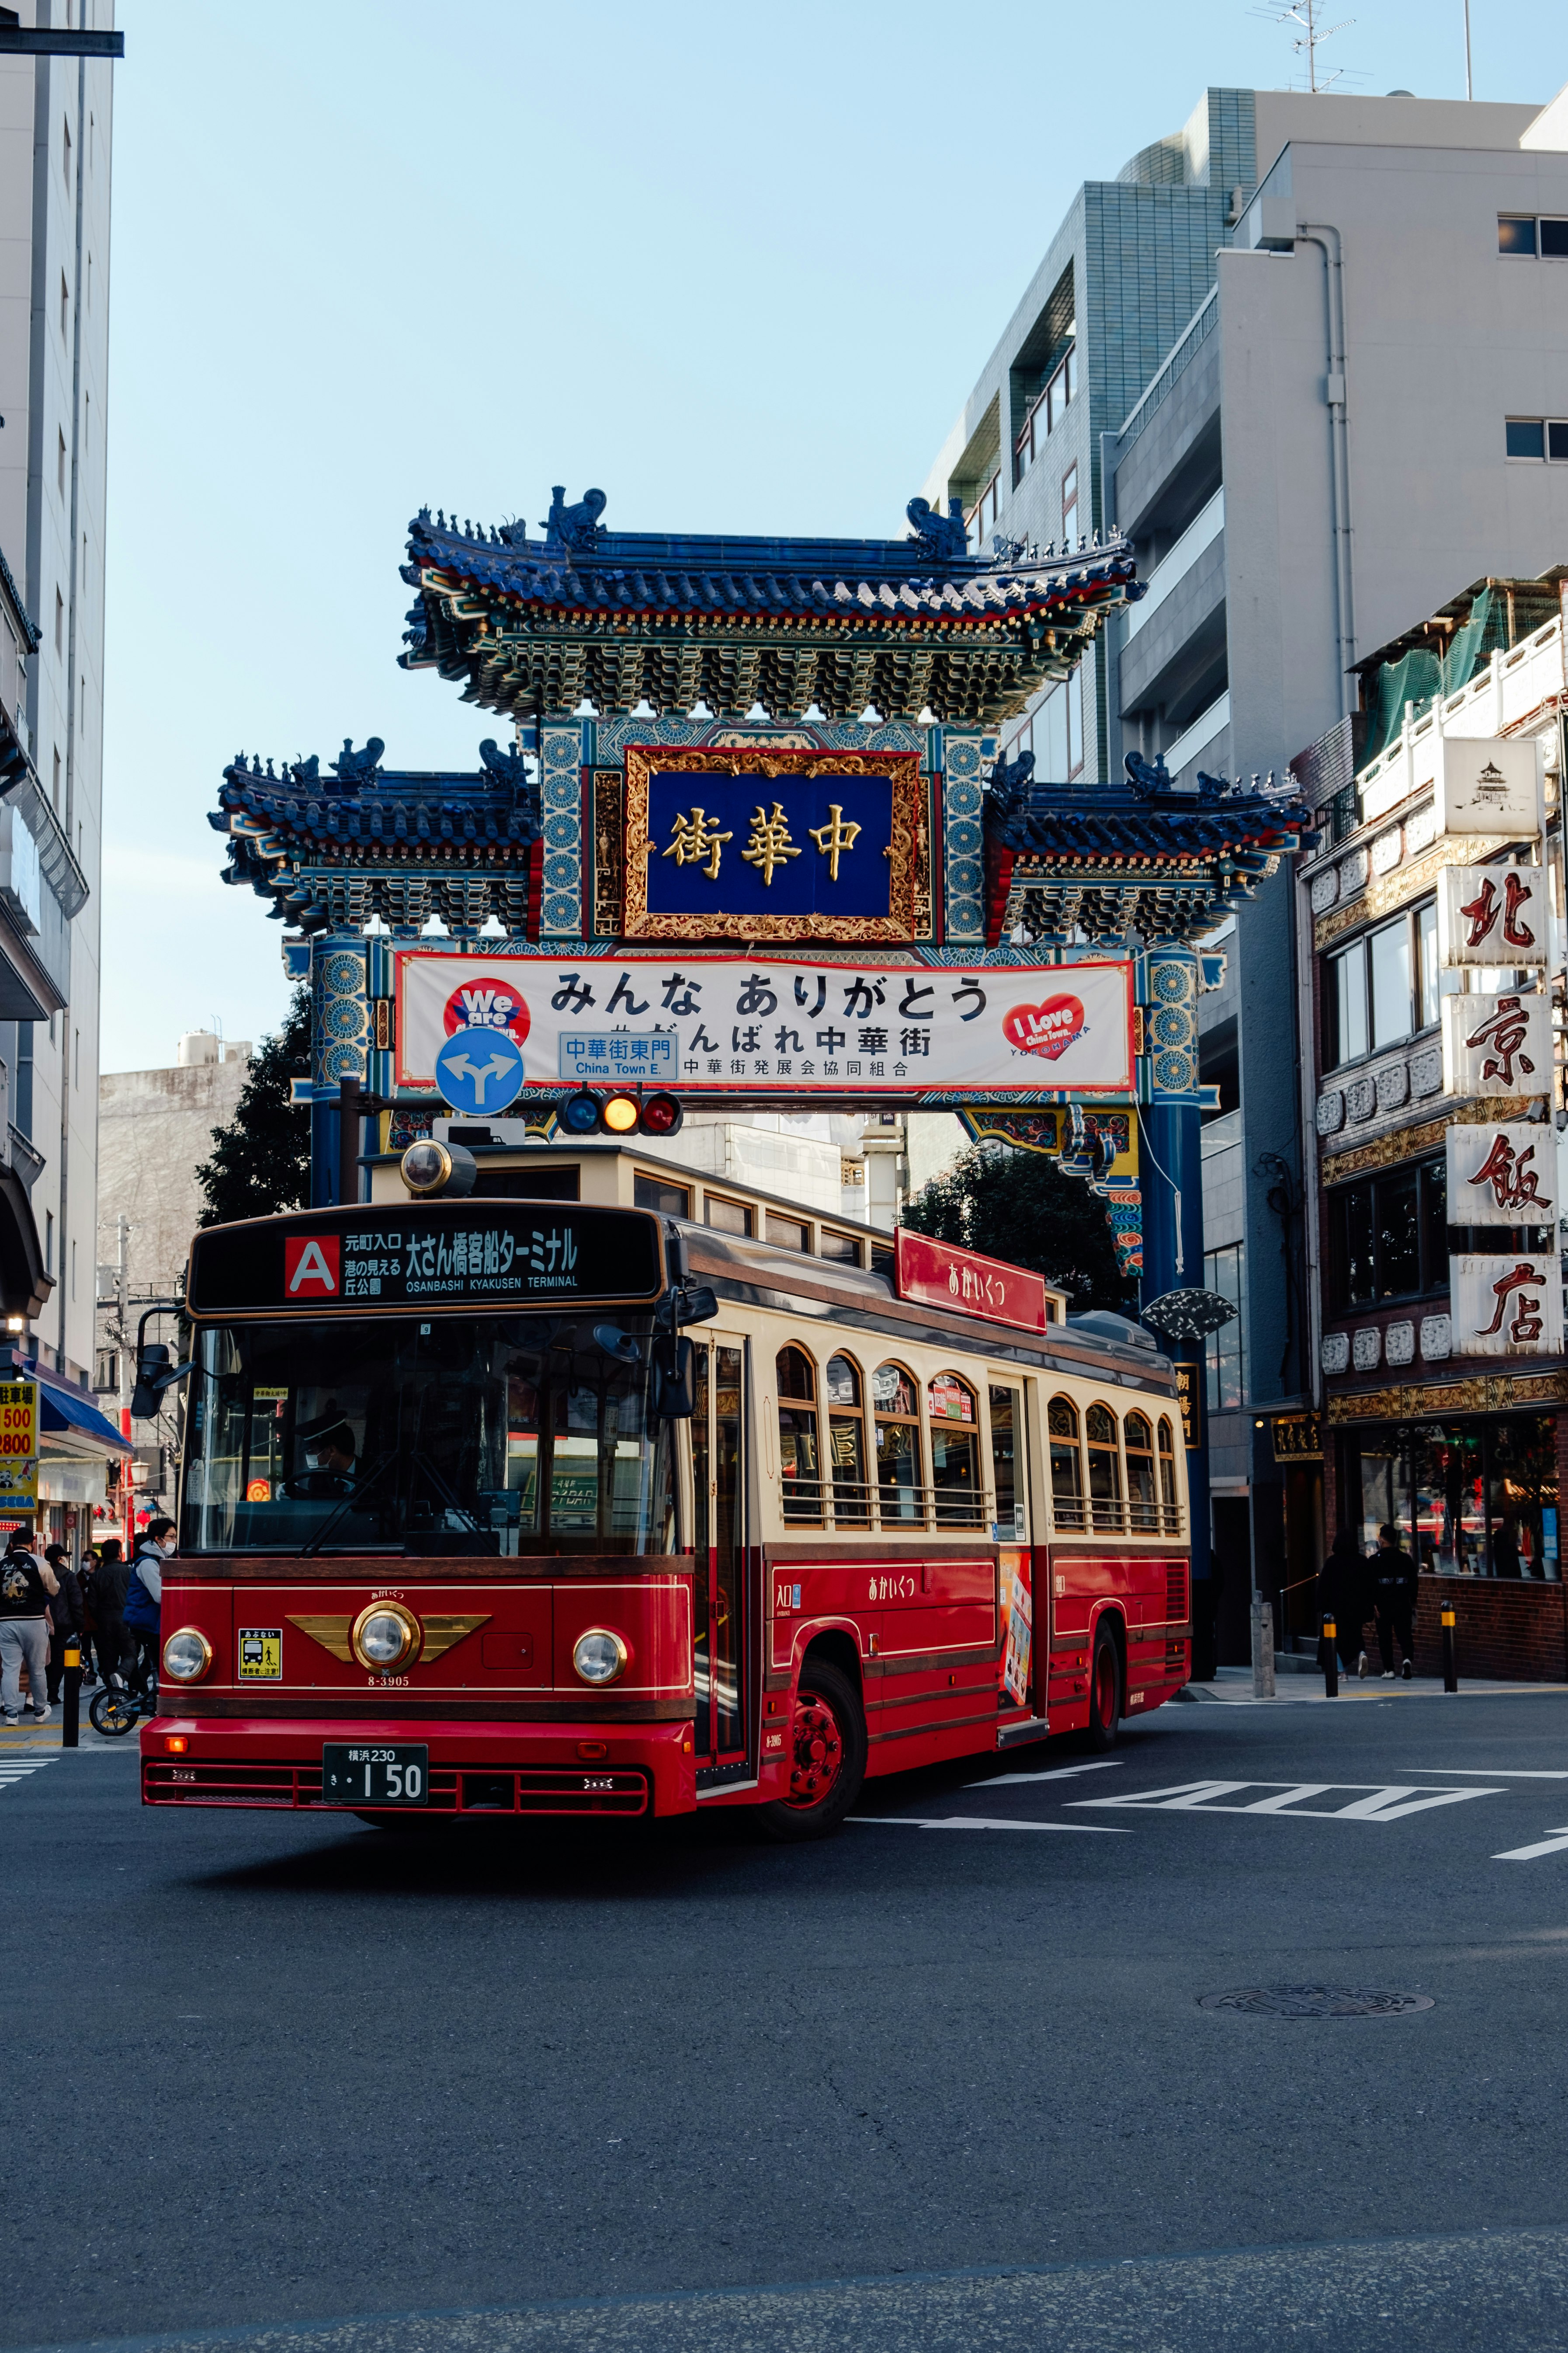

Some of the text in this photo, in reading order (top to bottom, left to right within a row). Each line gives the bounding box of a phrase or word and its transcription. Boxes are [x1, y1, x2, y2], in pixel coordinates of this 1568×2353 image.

[461, 990, 513, 1013] We
[550, 972, 987, 1022] みんな ありがとう
[468, 1012, 506, 1025] are
[1013, 1009, 1073, 1038] I Love
[567, 1038, 670, 1060] 中華街東門
[1011, 1026, 1091, 1056] YOKOHAMA
[576, 1062, 661, 1074] China Town E.
[684, 1058, 909, 1077] 中華街発展会協同組合
[1460, 872, 1554, 1343] 北京飯店
[345, 1234, 402, 1251] 元町入口
[406, 1228, 578, 1277] 大さん橋客船ターミナル
[289, 1241, 335, 1292] A
[344, 1258, 401, 1277] 港の見える
[344, 1278, 381, 1295] 丘公園
[406, 1276, 578, 1292] OSANBASHI KYAKUSEN TERMINAL
[949, 1263, 1005, 1305] あかいくつ
[0, 1408, 31, 1428] 500
[0, 1434, 31, 1454] 800
[776, 1585, 791, 1607] 入口
[869, 1575, 915, 1601] あかいくつ
[368, 1676, 409, 1686] 8-3905
[767, 1734, 782, 1748] 8-3905
